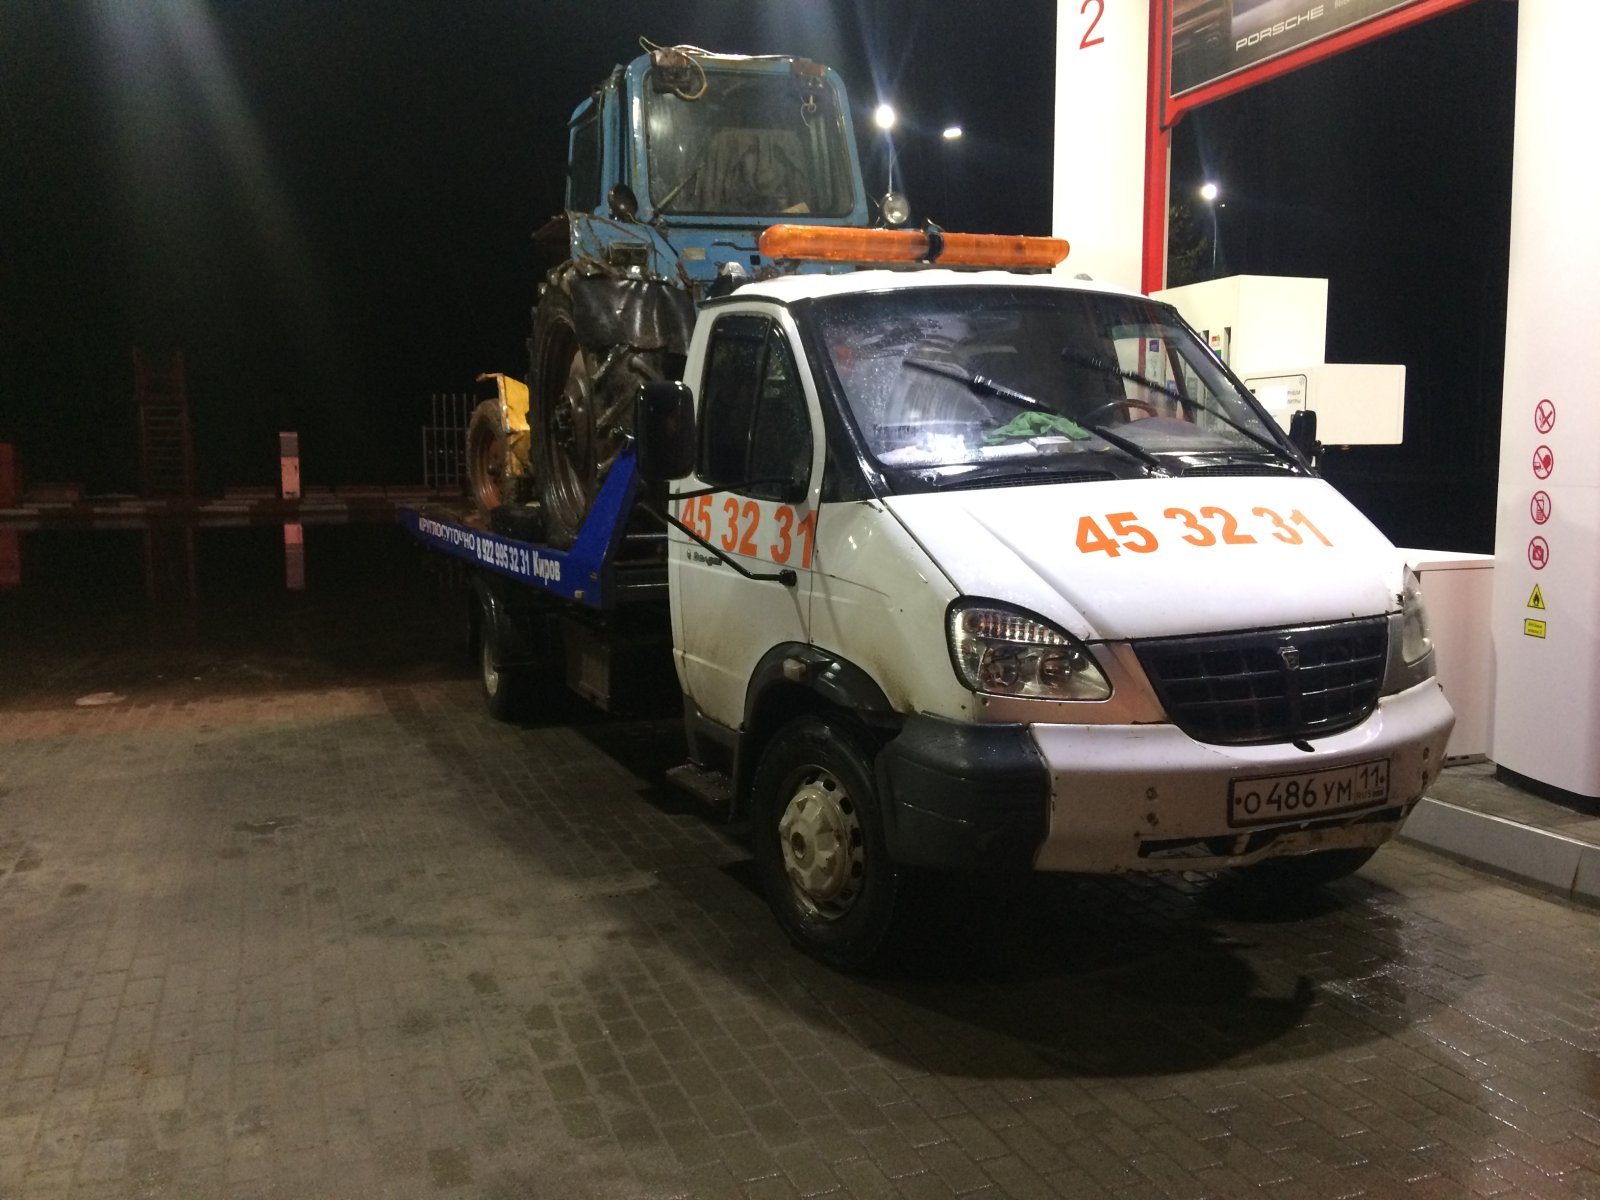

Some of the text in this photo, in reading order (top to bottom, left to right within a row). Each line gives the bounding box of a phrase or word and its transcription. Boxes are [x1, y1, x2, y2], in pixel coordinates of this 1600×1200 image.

[1079, 0, 1105, 50] 2
[1235, 4, 1325, 52] PORSCHE
[681, 495, 817, 569] 45 32 31
[1075, 506, 1334, 558] 45 32 31
[476, 536, 482, 560] 8
[482, 538, 495, 565] 922
[495, 542, 509, 569] 995
[508, 546, 520, 573] 32
[520, 548, 531, 576] 31
[532, 550, 561, 586] Киров
[1359, 764, 1380, 789] 11
